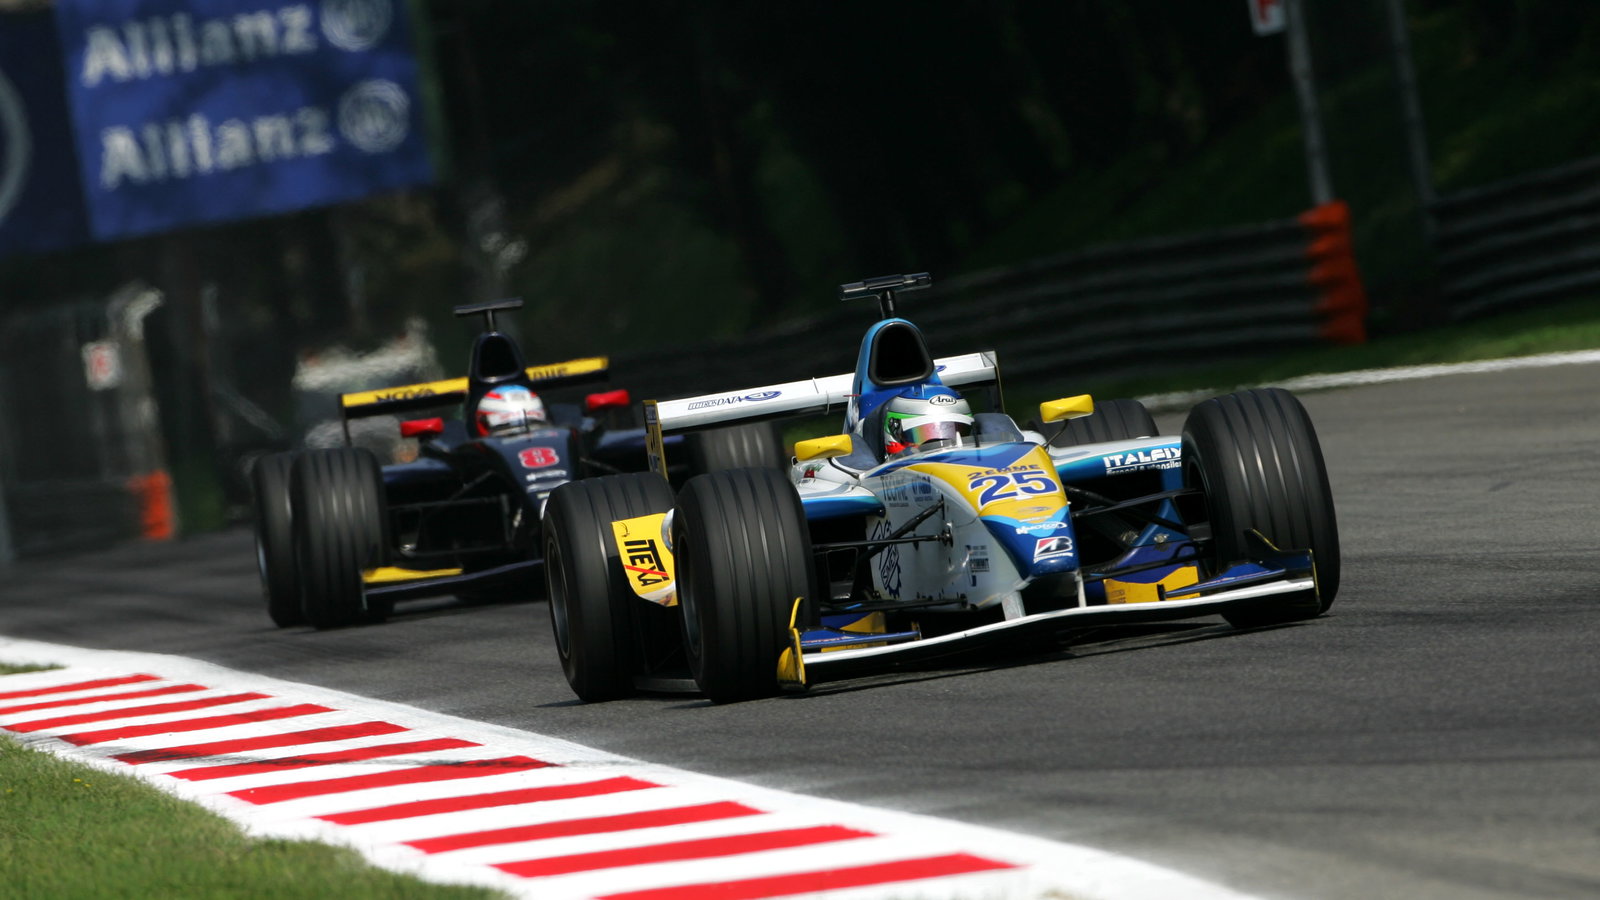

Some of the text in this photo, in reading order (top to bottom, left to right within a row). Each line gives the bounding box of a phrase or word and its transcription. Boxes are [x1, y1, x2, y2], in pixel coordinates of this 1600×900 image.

[81, 6, 318, 88] Allianz
[101, 106, 334, 190] Allianz
[932, 395, 954, 404] Arai
[517, 446, 560, 469] 8
[967, 464, 1041, 480] 2EMME
[968, 470, 1060, 511] 25
